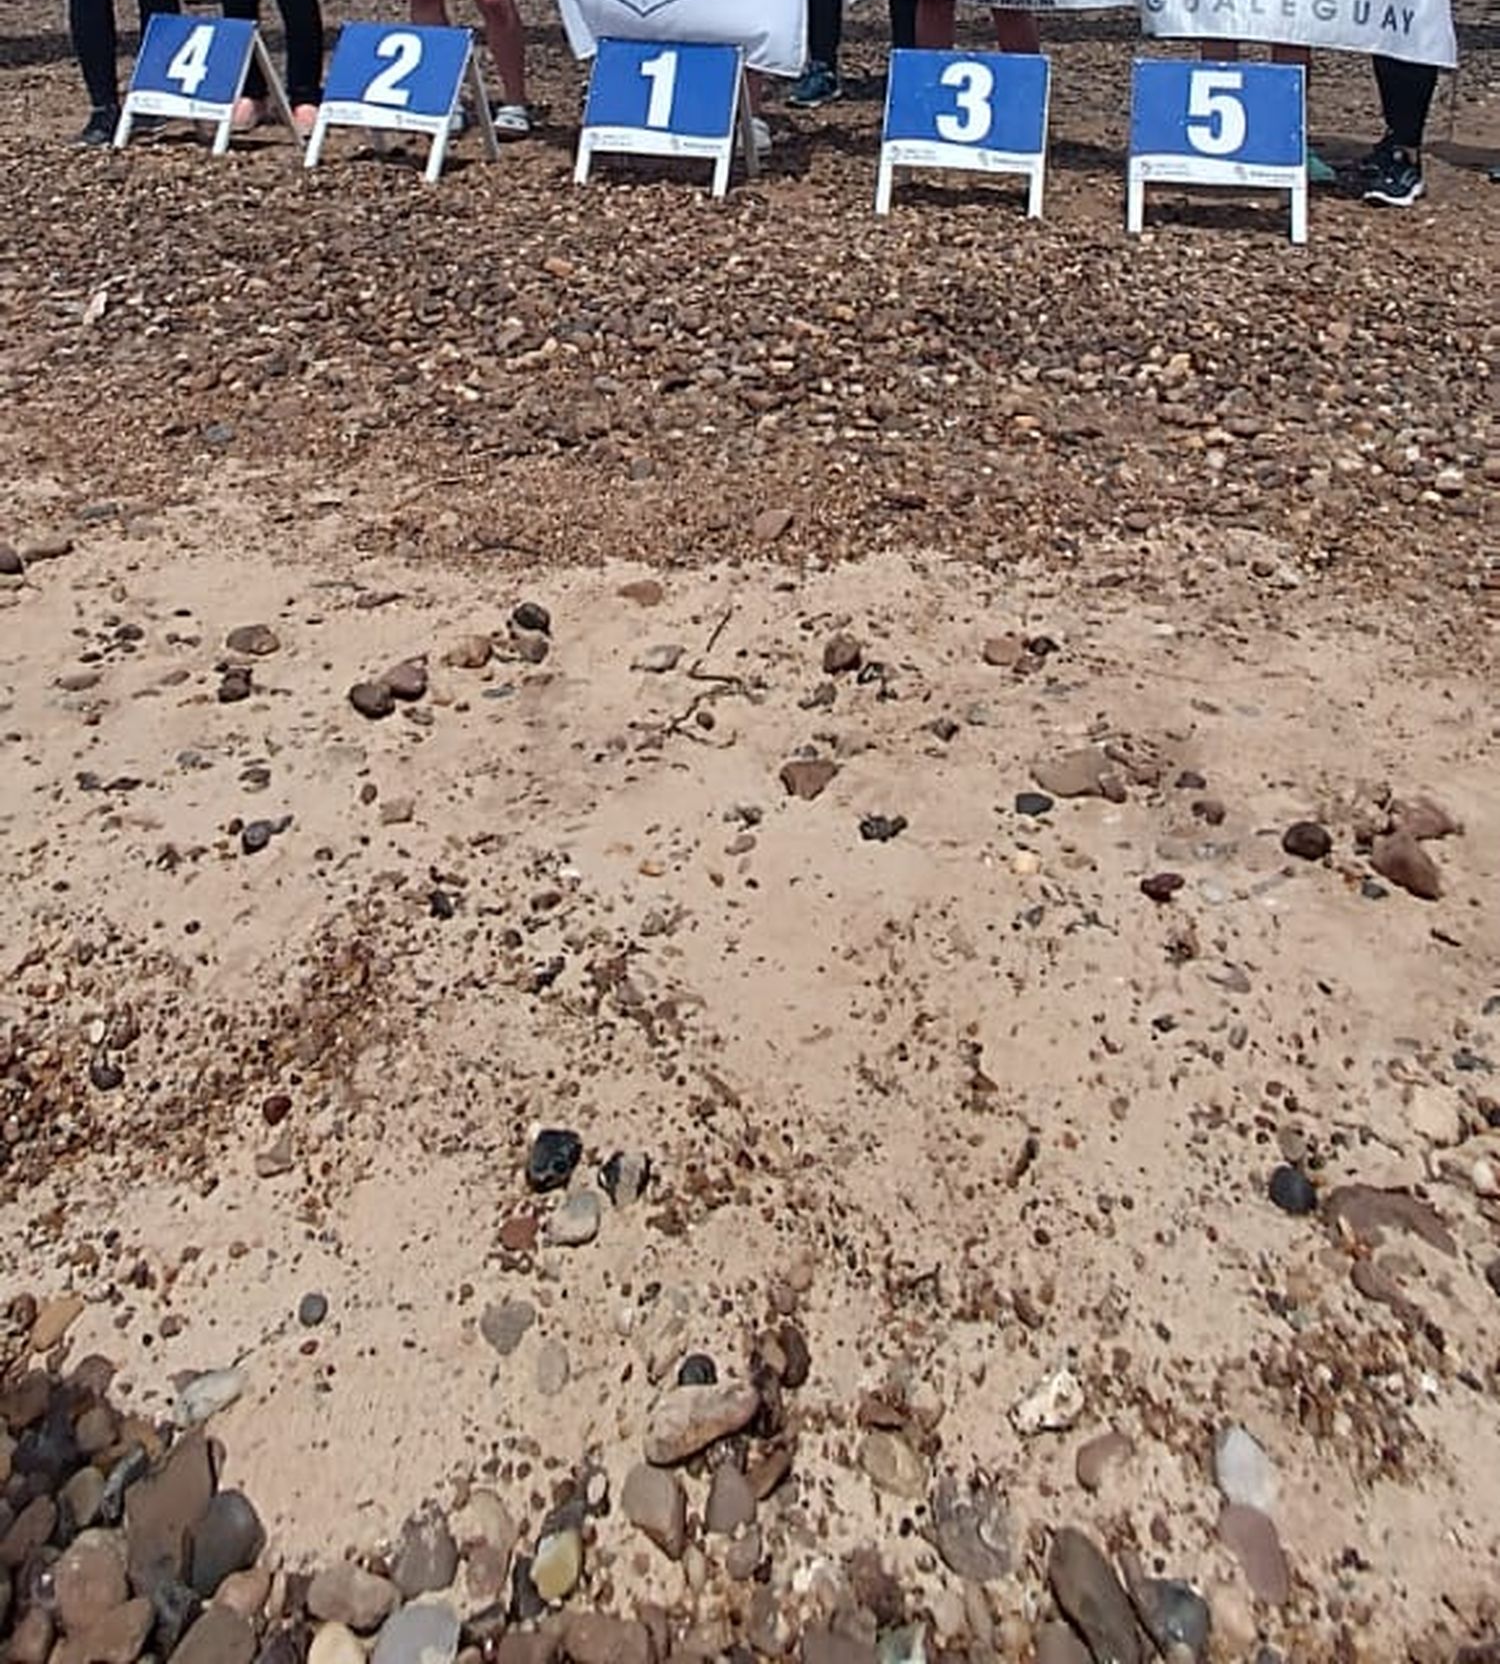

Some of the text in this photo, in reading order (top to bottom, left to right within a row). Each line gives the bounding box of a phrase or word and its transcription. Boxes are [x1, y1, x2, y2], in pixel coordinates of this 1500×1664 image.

[166, 24, 216, 95] 4
[362, 32, 424, 107] 2
[640, 50, 679, 129] 1
[935, 60, 994, 144] 3
[1186, 70, 1247, 156] 5
